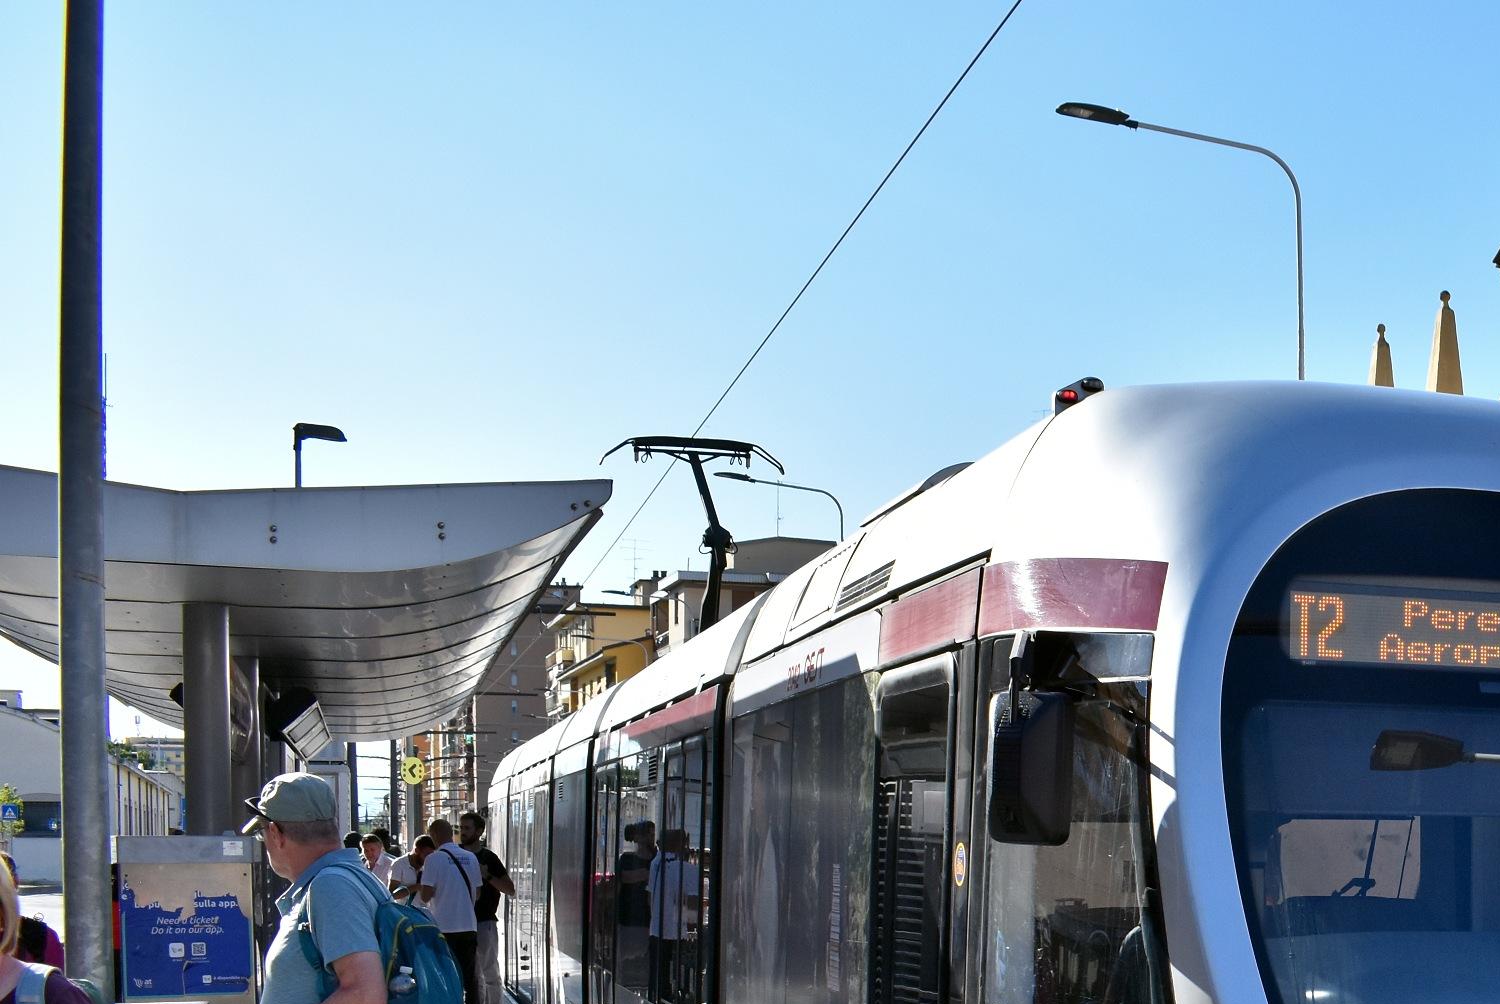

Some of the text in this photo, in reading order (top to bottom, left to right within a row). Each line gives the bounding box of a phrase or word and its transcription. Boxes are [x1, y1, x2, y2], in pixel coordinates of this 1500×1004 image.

[1294, 594, 1344, 658] T2
[194, 899, 216, 908] sulla
[218, 900, 238, 909] app.
[156, 916, 181, 925] Need
[151, 926, 225, 935] Do it on our app.
